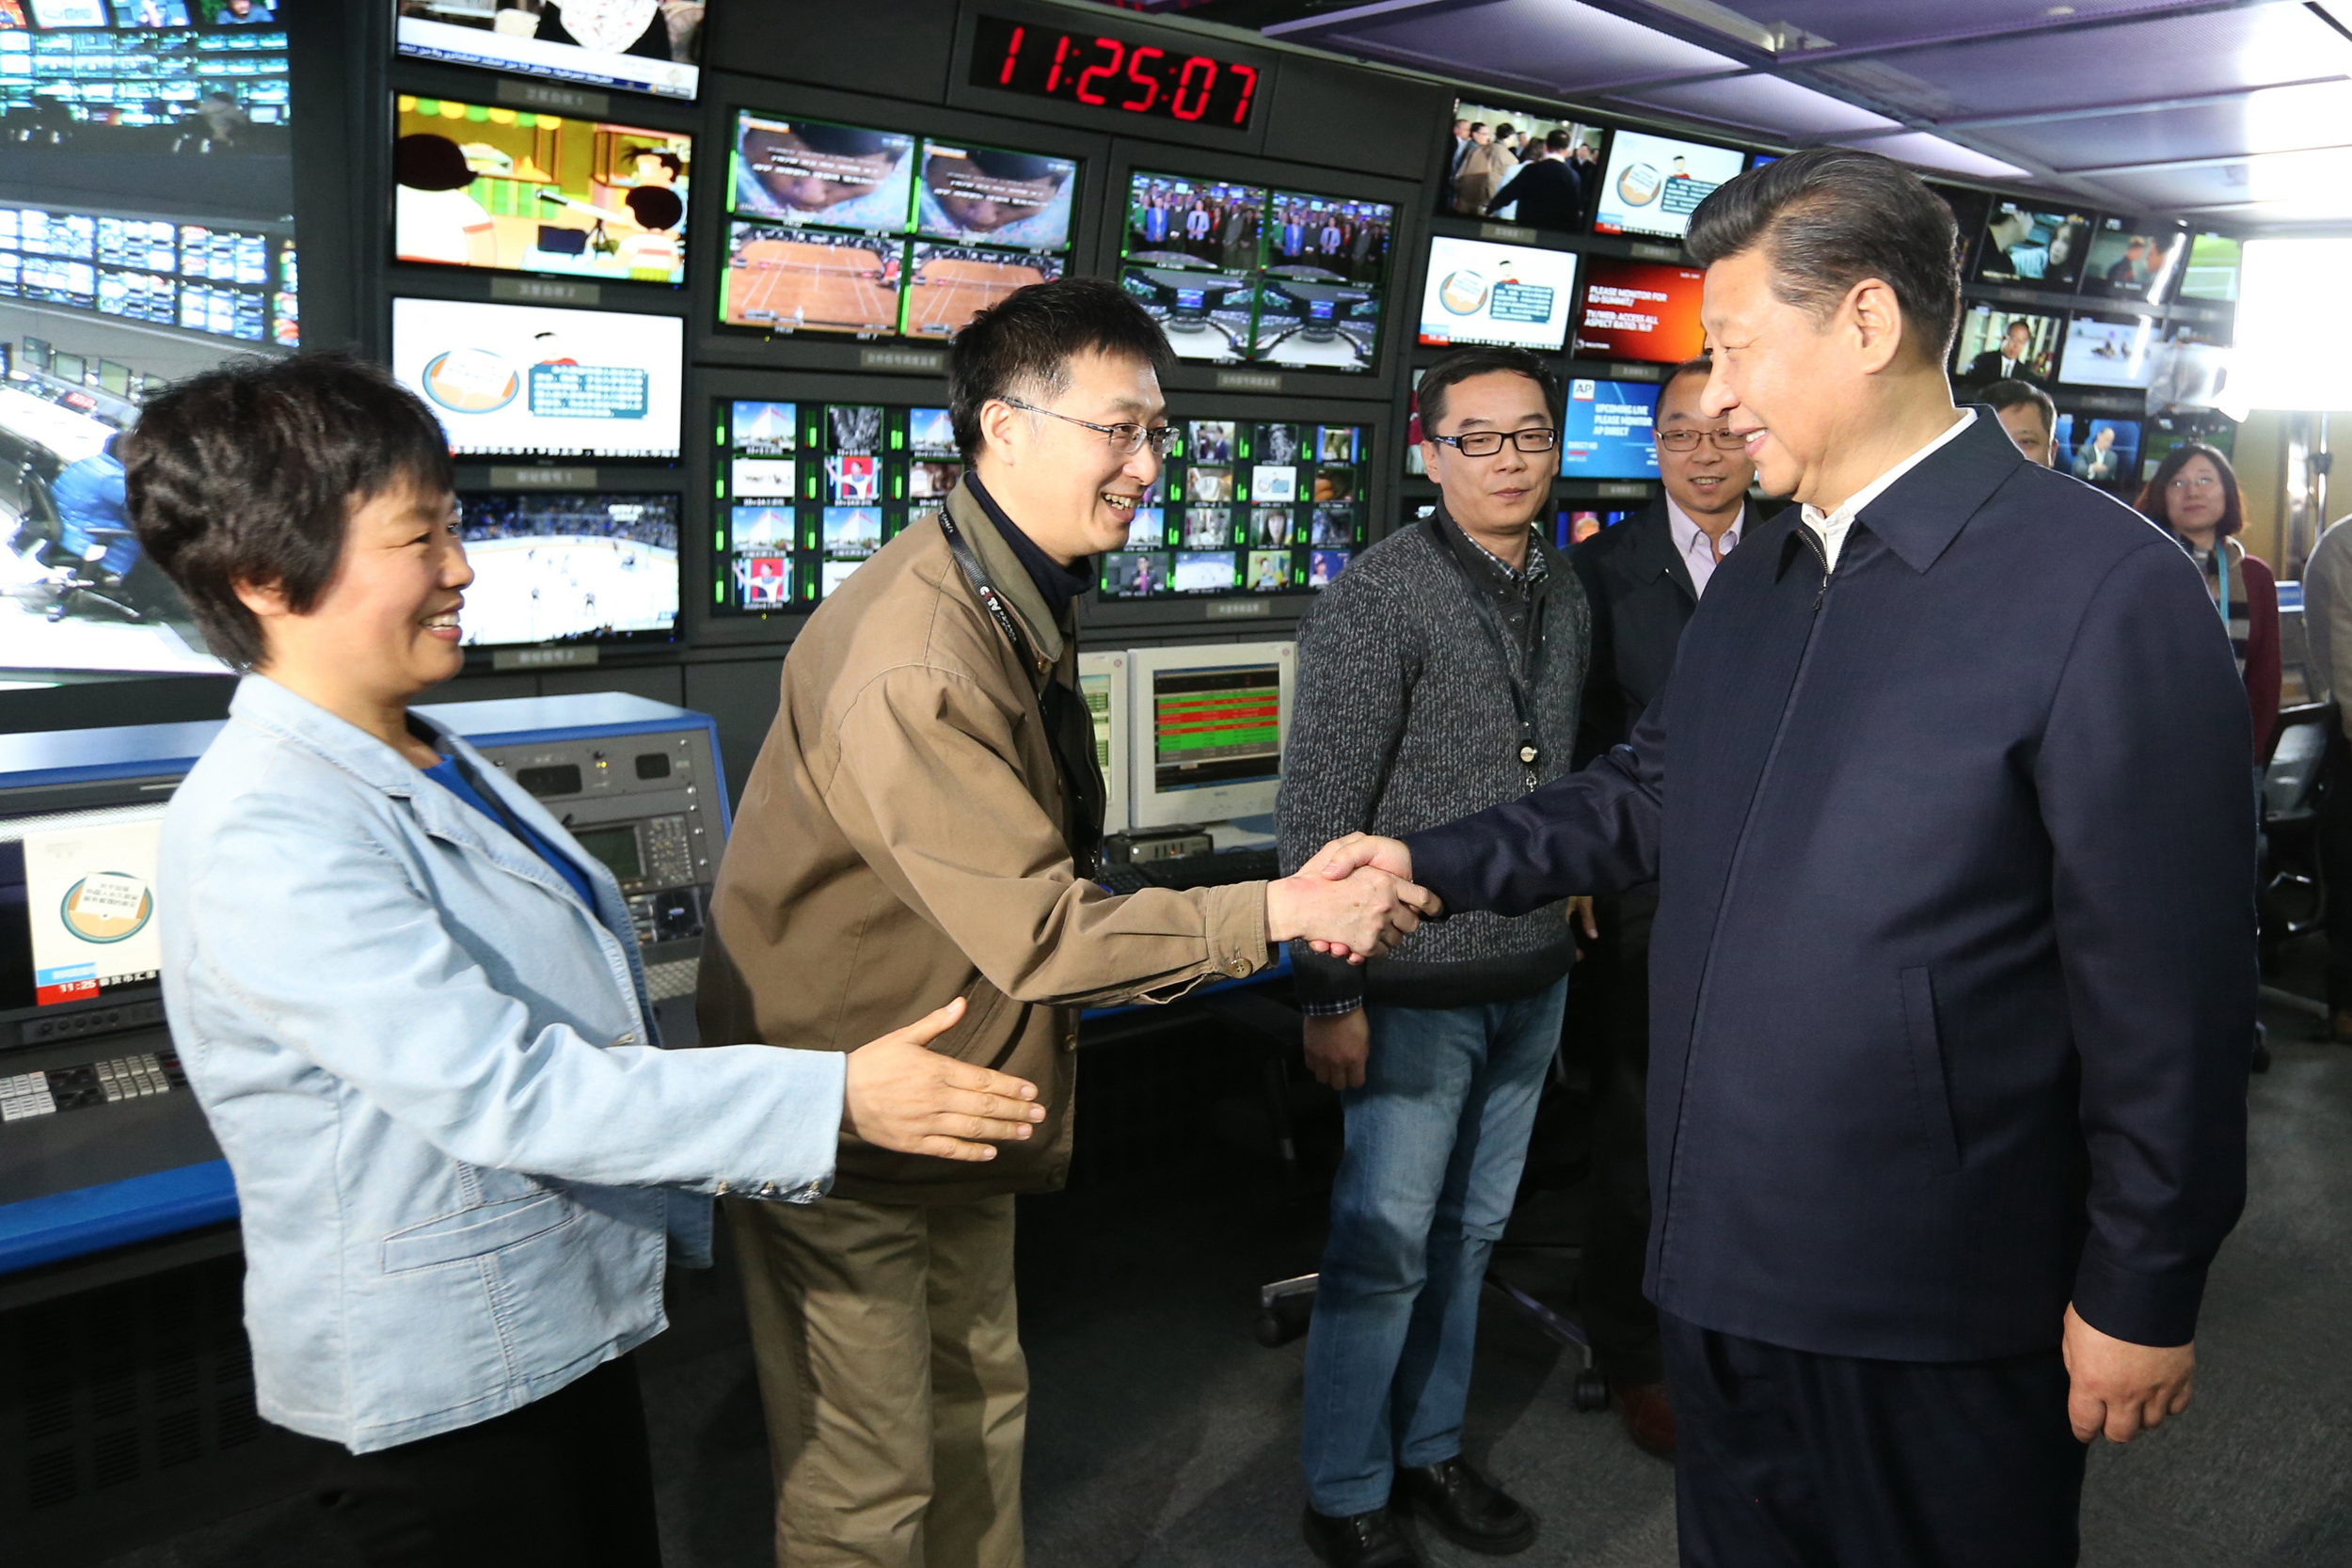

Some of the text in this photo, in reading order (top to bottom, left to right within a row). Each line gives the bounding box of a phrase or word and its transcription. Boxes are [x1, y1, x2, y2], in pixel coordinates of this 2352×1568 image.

[999, 25, 1257, 124] 11:25:07
[1589, 285, 1617, 296] PLEASE
[1653, 292, 1668, 302] FOR
[1645, 315, 1659, 325] ALL
[1576, 385, 1592, 393] AP
[1632, 405, 1649, 416] LIVE
[1594, 415, 1620, 425] PLEASE
[59, 980, 97, 993] 11:25
